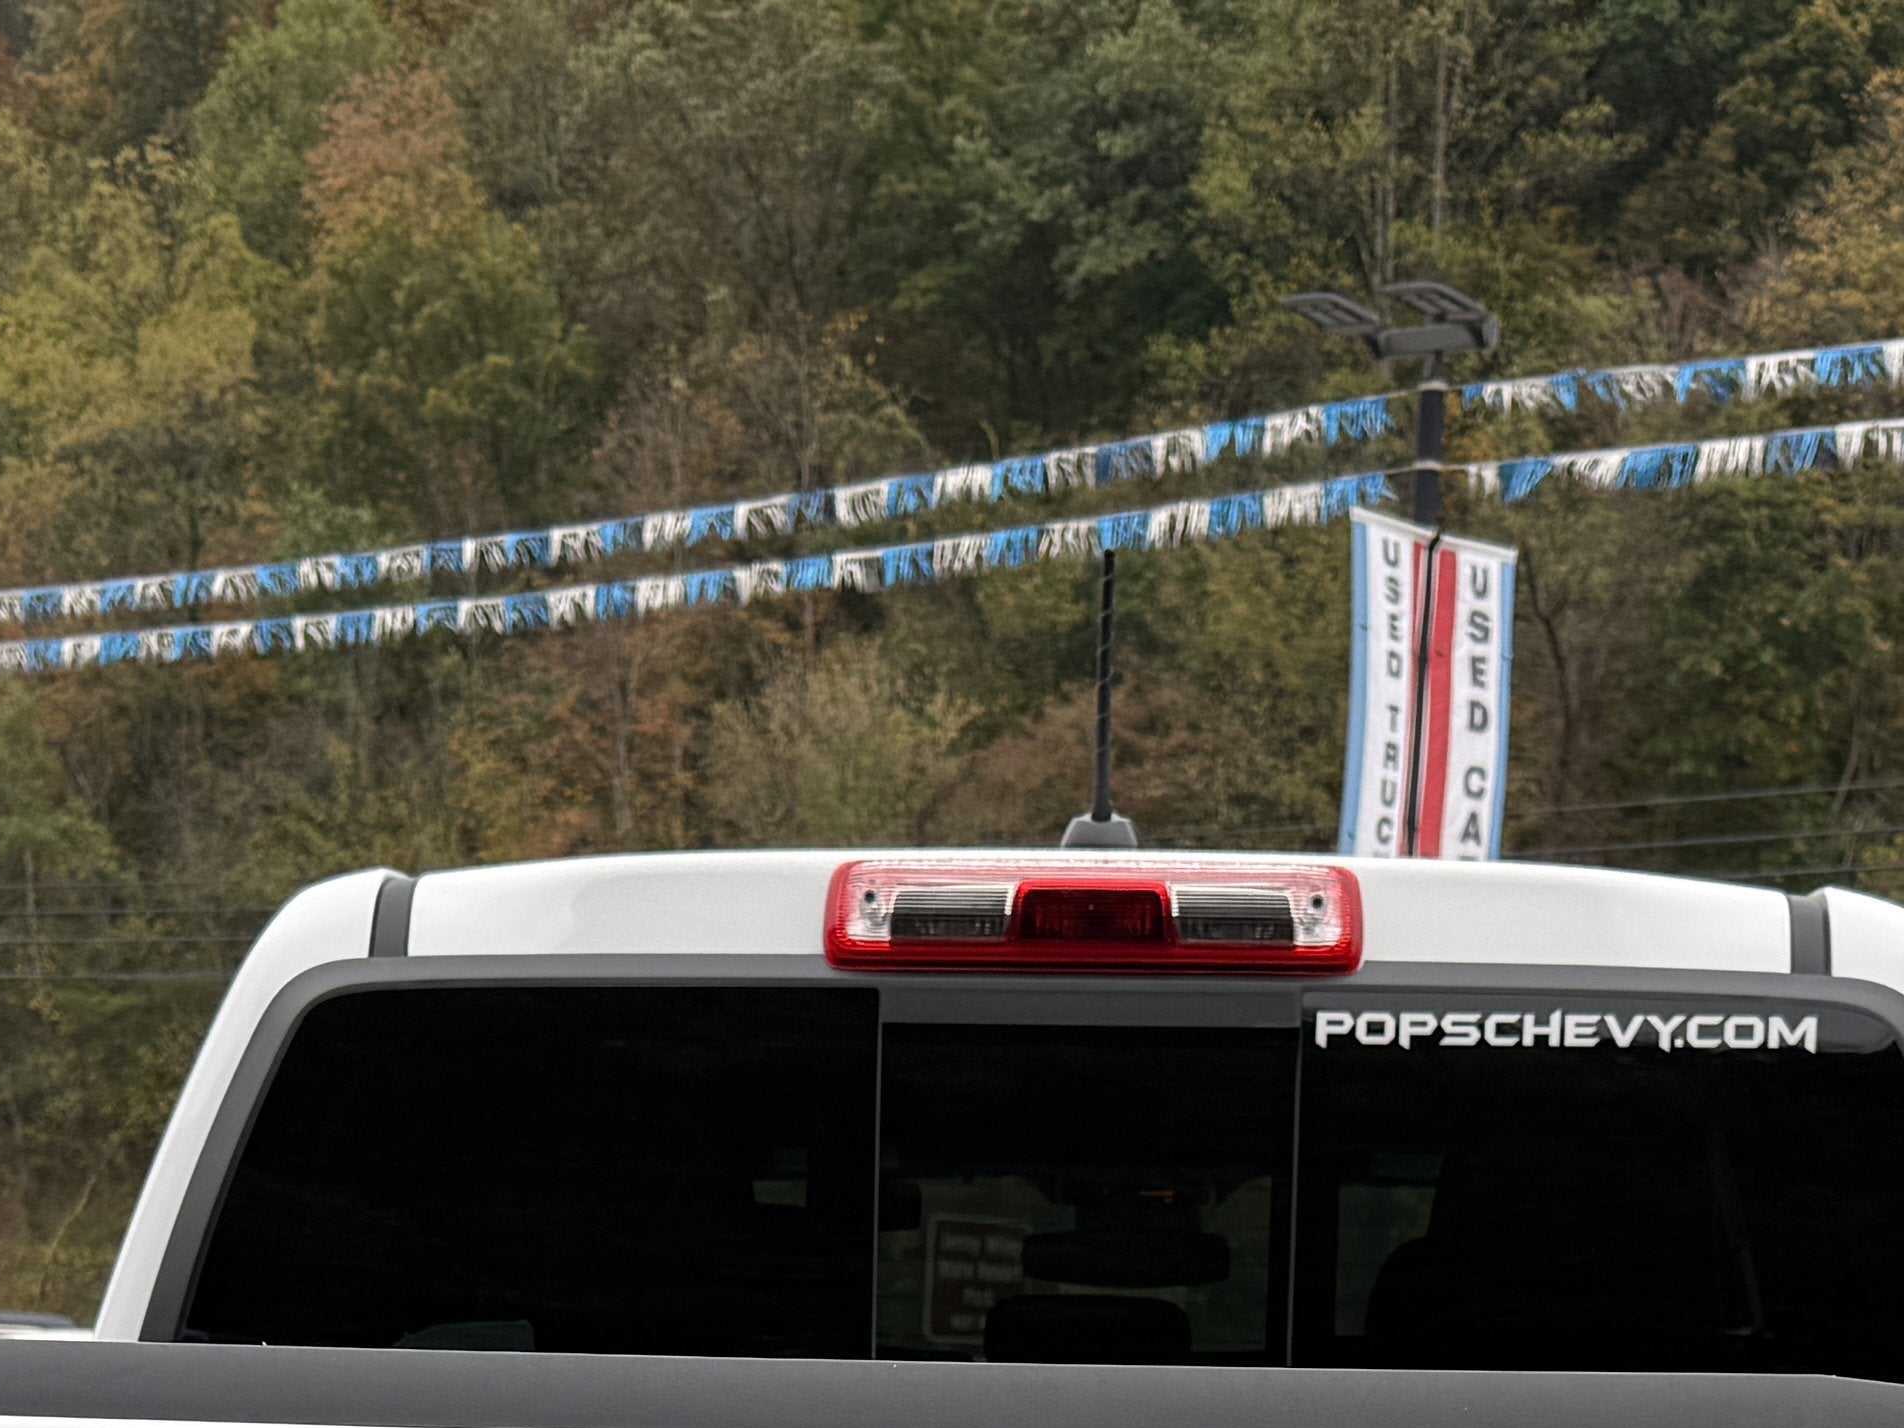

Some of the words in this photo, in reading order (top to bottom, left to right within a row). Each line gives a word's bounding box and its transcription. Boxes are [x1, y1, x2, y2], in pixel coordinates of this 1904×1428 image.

[1381, 537, 1404, 680] USED
[1467, 563, 1490, 733] USED
[1374, 703, 1400, 859] TRUC
[1458, 765, 1487, 861] CA
[1315, 1009, 1818, 1054] POPSCHEVY.COM
